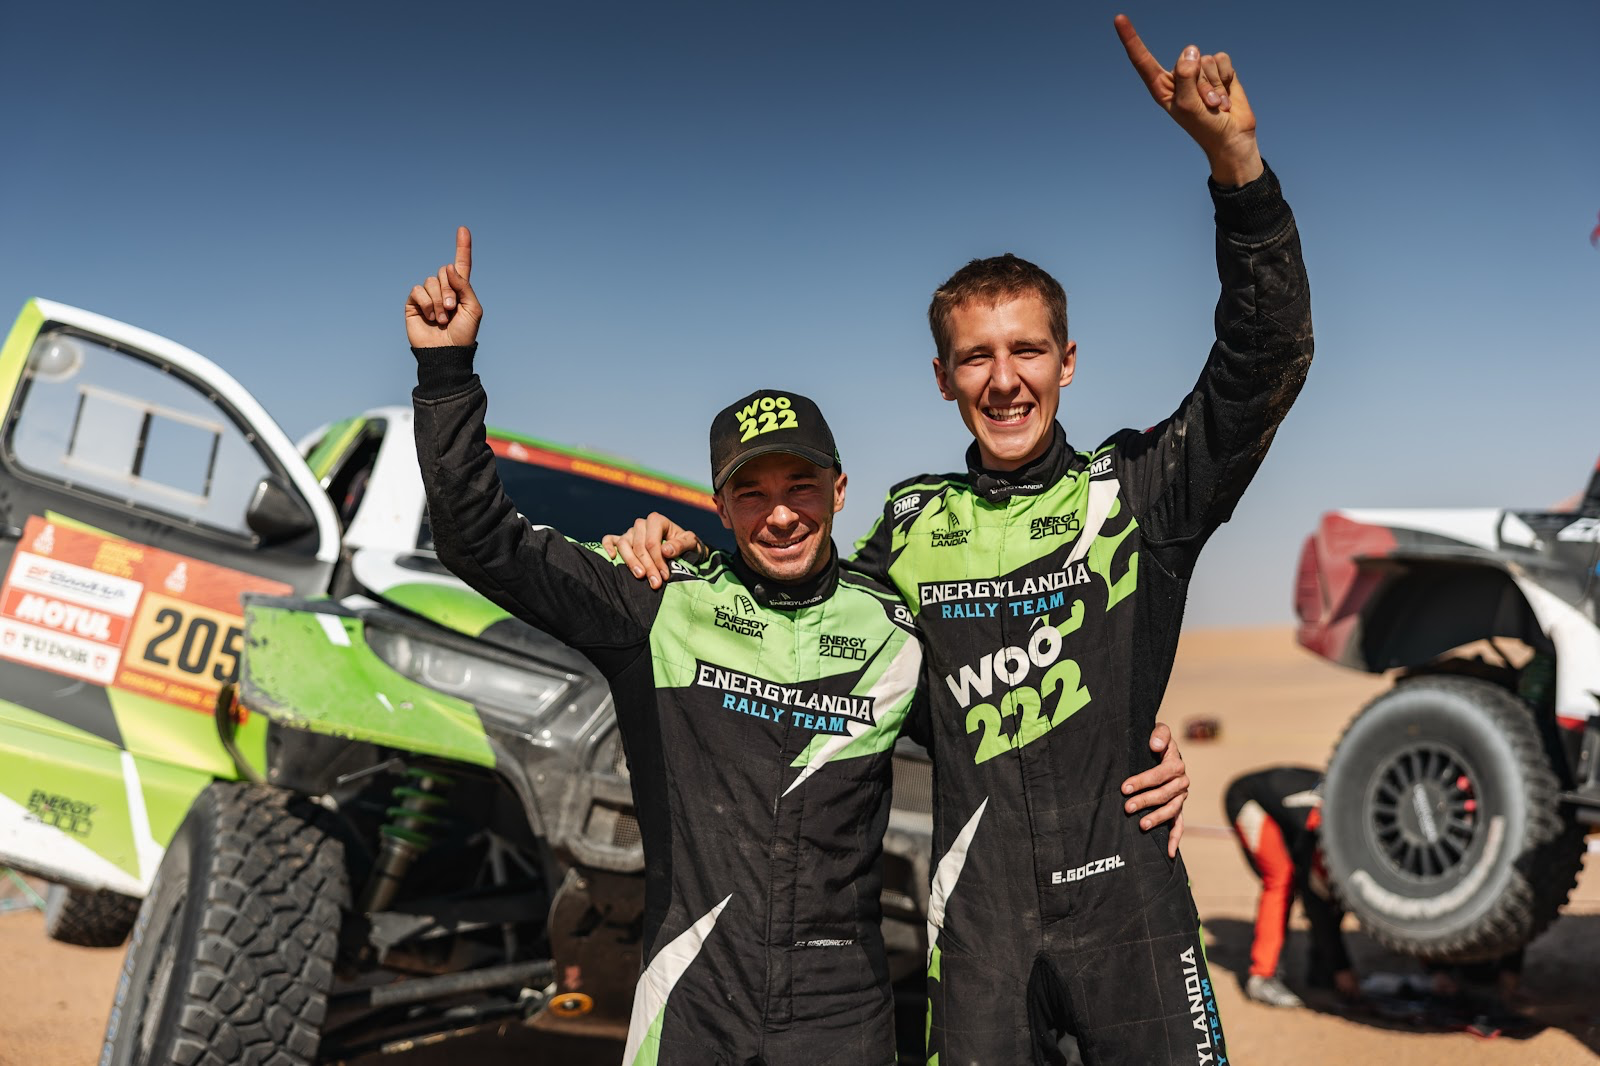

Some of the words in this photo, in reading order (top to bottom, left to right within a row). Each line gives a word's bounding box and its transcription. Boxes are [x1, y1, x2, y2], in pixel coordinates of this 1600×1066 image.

[735, 397, 791, 423] WOO
[739, 409, 799, 443] 222
[1090, 458, 1112, 475] MP
[893, 496, 920, 516] OMP
[1030, 509, 1079, 529] ENERGY
[931, 529, 972, 540] ENERGY
[931, 536, 969, 548] LANDIA
[1030, 519, 1080, 540] 2000
[921, 563, 1092, 606] ENERGYLANDIA
[15, 594, 112, 640] MOTUL
[941, 602, 996, 619] RALLY
[1008, 592, 1065, 617] TEAM
[714, 619, 763, 639] LANDIA
[716, 611, 769, 631] ENERGY
[144, 608, 243, 684] 205
[819, 645, 867, 661] 2000
[820, 634, 867, 648] ENERGY
[697, 664, 874, 722] ENERGYLANDIA
[722, 692, 785, 723] RALLY
[792, 712, 845, 733] TEAM
[965, 659, 1092, 765] 222
[28, 789, 96, 816] ENERGY
[1051, 854, 1126, 885] E.GOCZAŁ
[1180, 945, 1214, 1066] YLANDIA
[1200, 978, 1223, 1045] TEAM
